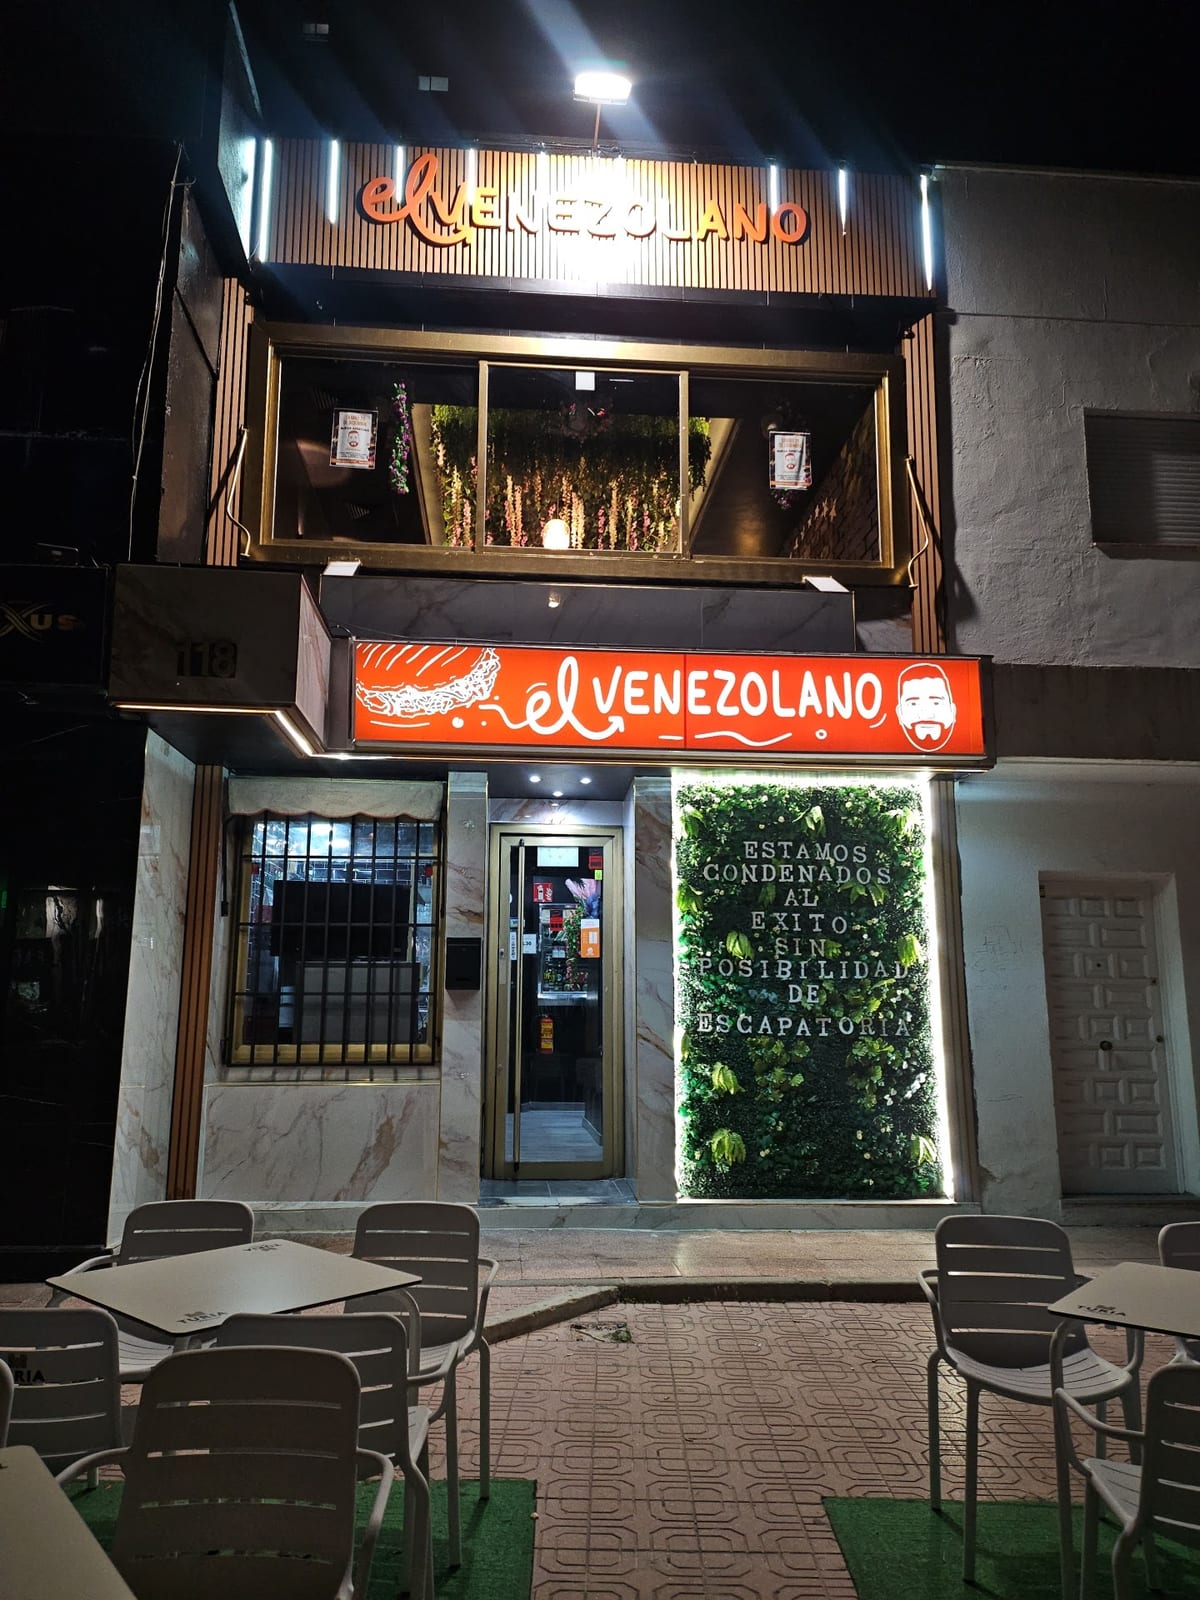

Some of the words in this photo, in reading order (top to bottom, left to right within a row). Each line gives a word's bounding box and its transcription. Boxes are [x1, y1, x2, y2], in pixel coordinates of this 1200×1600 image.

[361, 153, 476, 247] el
[429, 181, 808, 245] VENEZOLANO
[176, 638, 238, 678] 118
[592, 665, 882, 720] VENEZOLANO
[743, 841, 867, 863] ESTAMOS
[703, 863, 891, 885] CONDENADOS
[784, 888, 819, 907] AL
[751, 911, 848, 934] EXITO
[775, 938, 826, 957] SIN
[699, 957, 909, 979] POSIBILIDAD
[788, 984, 820, 1004] DE
[697, 1013, 911, 1037] ESCAPATORIA
[14, 1369, 45, 1382] RIA
